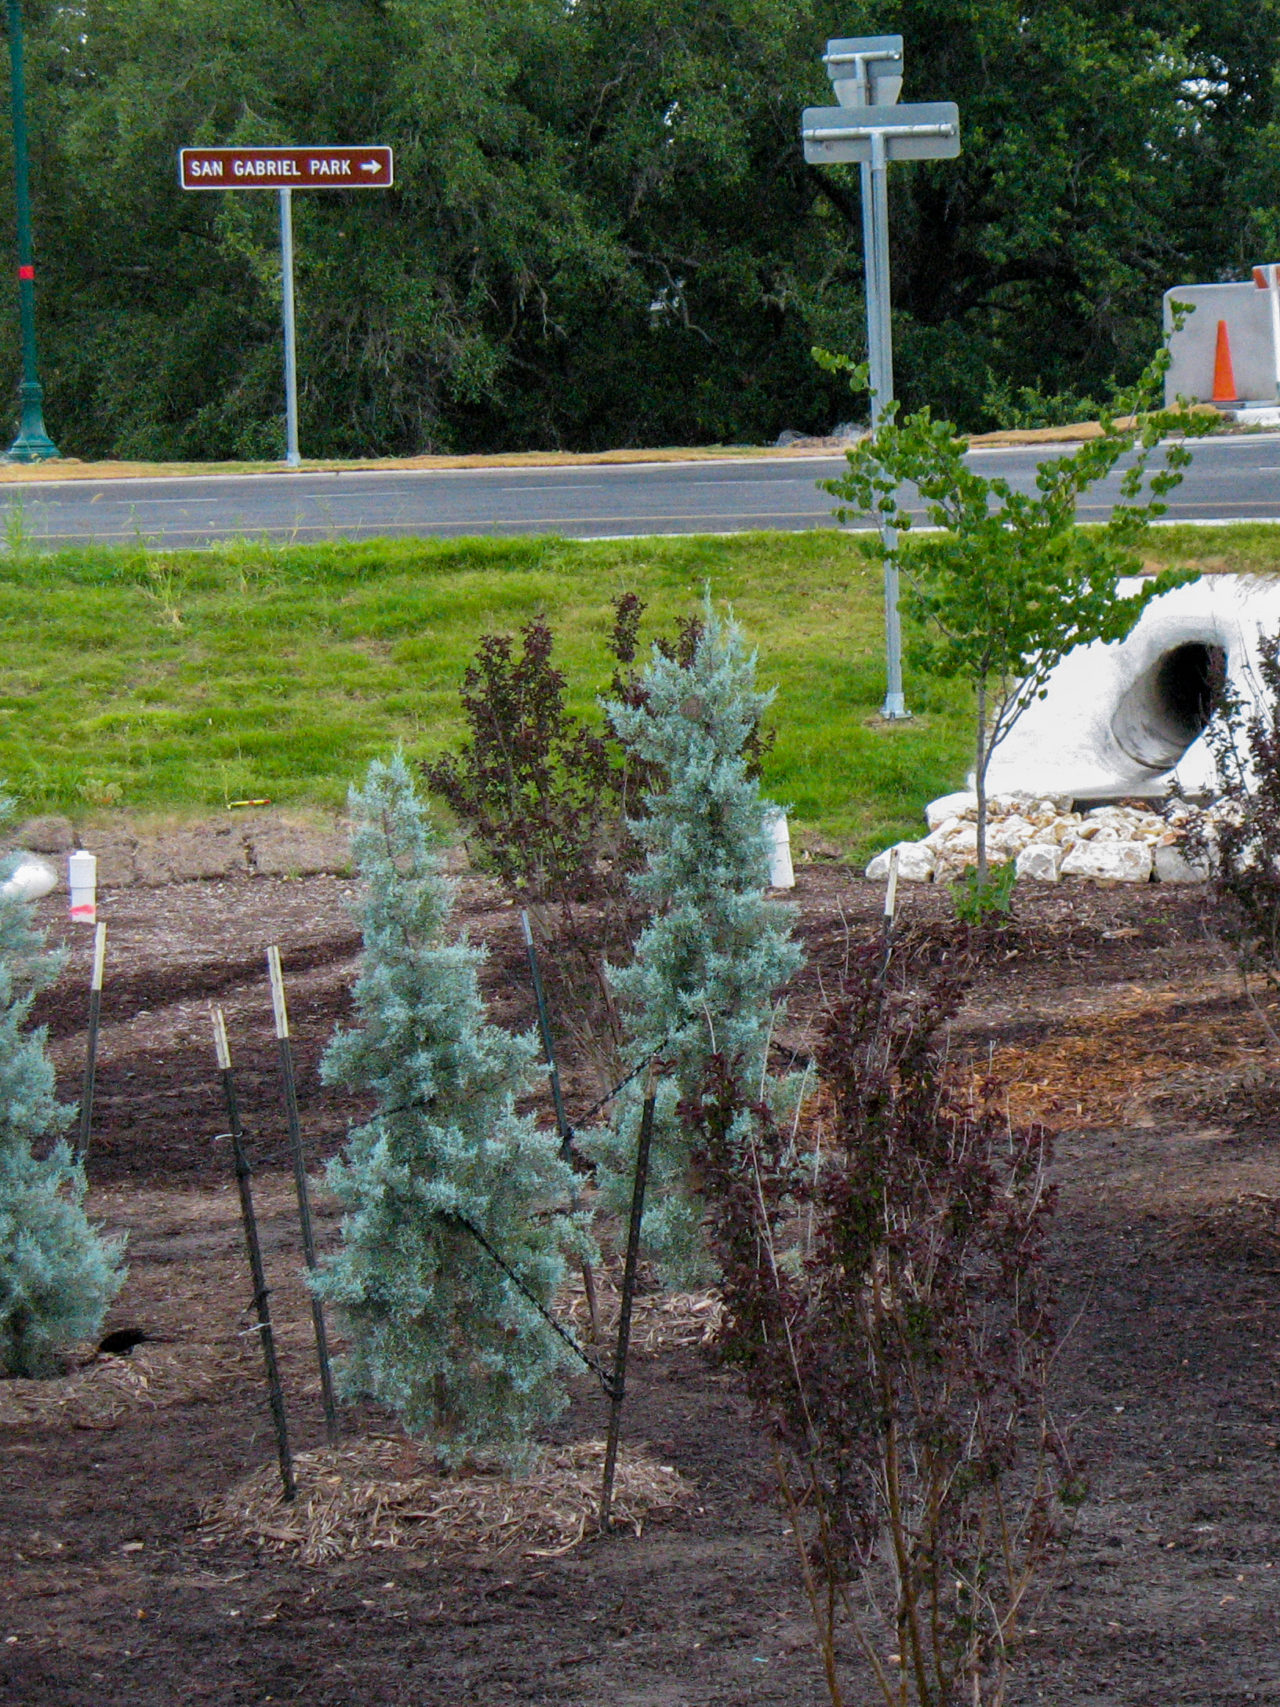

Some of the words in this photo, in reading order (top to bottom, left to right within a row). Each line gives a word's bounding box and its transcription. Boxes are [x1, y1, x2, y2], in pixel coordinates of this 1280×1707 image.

[191, 161, 223, 176] SAN
[234, 160, 301, 176] GABRIEL
[310, 159, 352, 175] PARK
